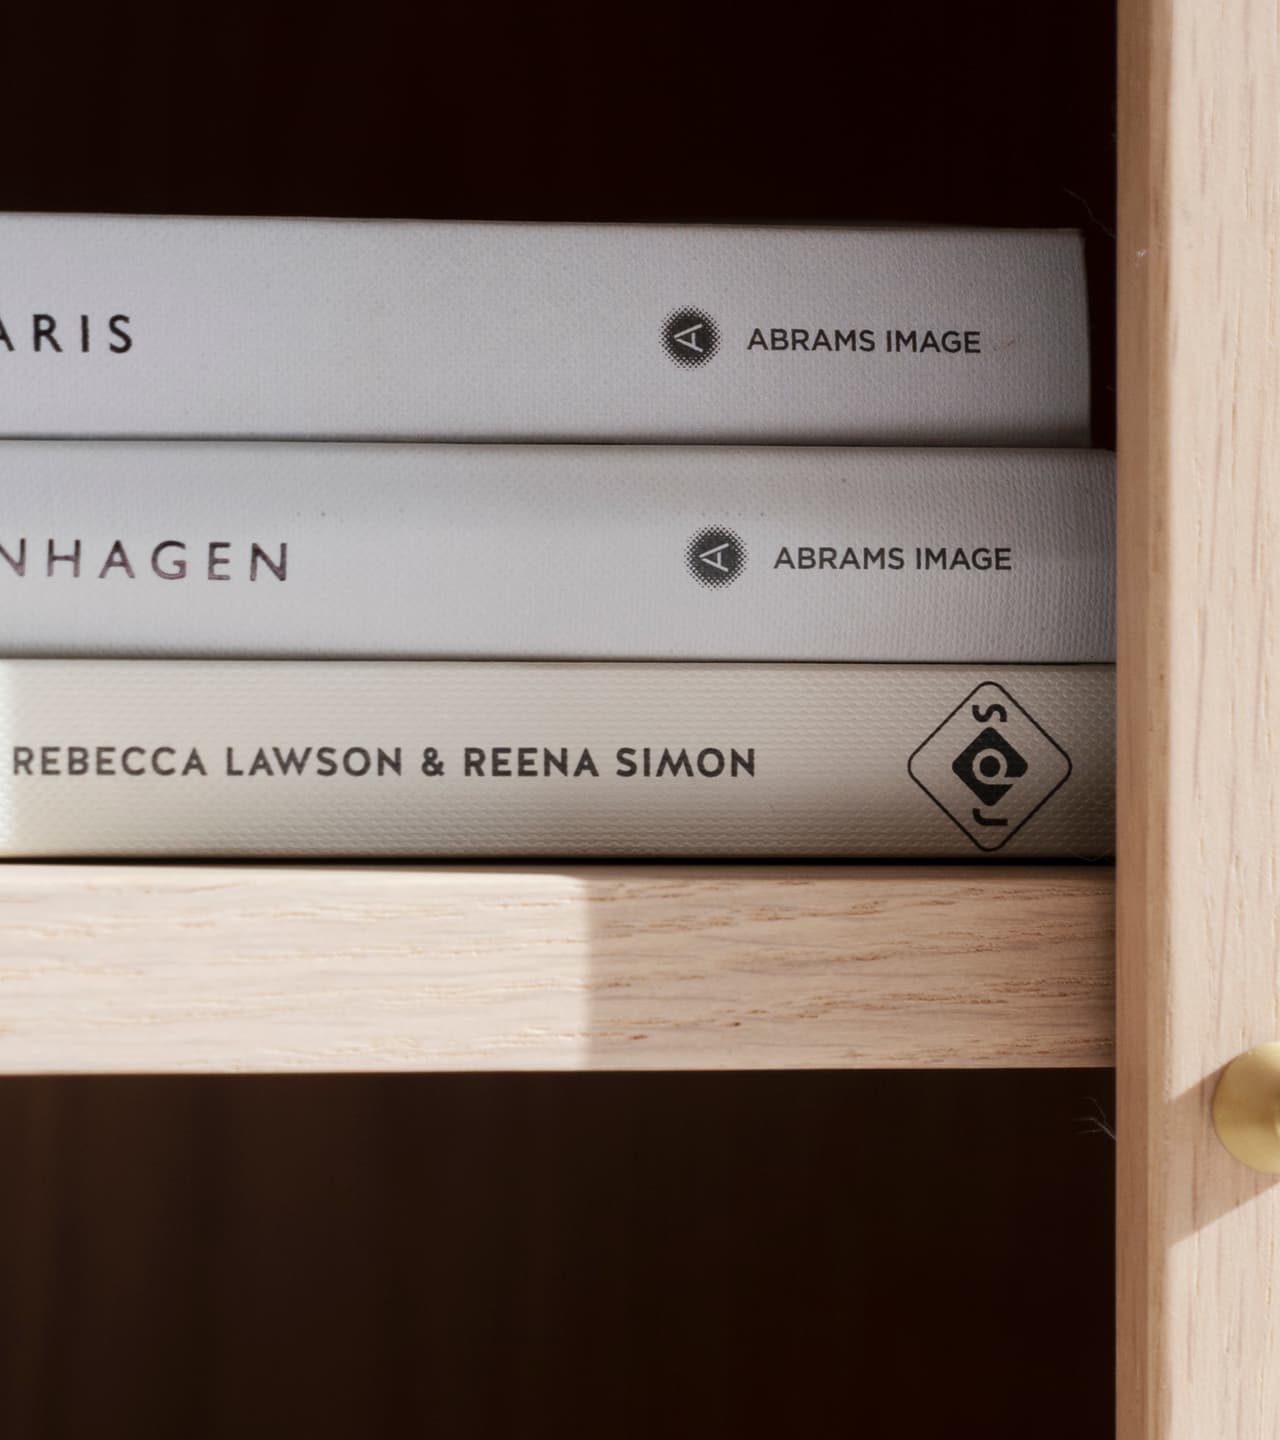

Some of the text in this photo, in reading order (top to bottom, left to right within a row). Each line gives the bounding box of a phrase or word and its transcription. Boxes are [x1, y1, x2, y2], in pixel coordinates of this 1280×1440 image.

[746, 327, 981, 354] ABRAMS IMAGE
[773, 546, 1012, 571] ABRAMS IMAGE
[12, 745, 755, 779] REBECCA LAWSON & REENA SIMON
